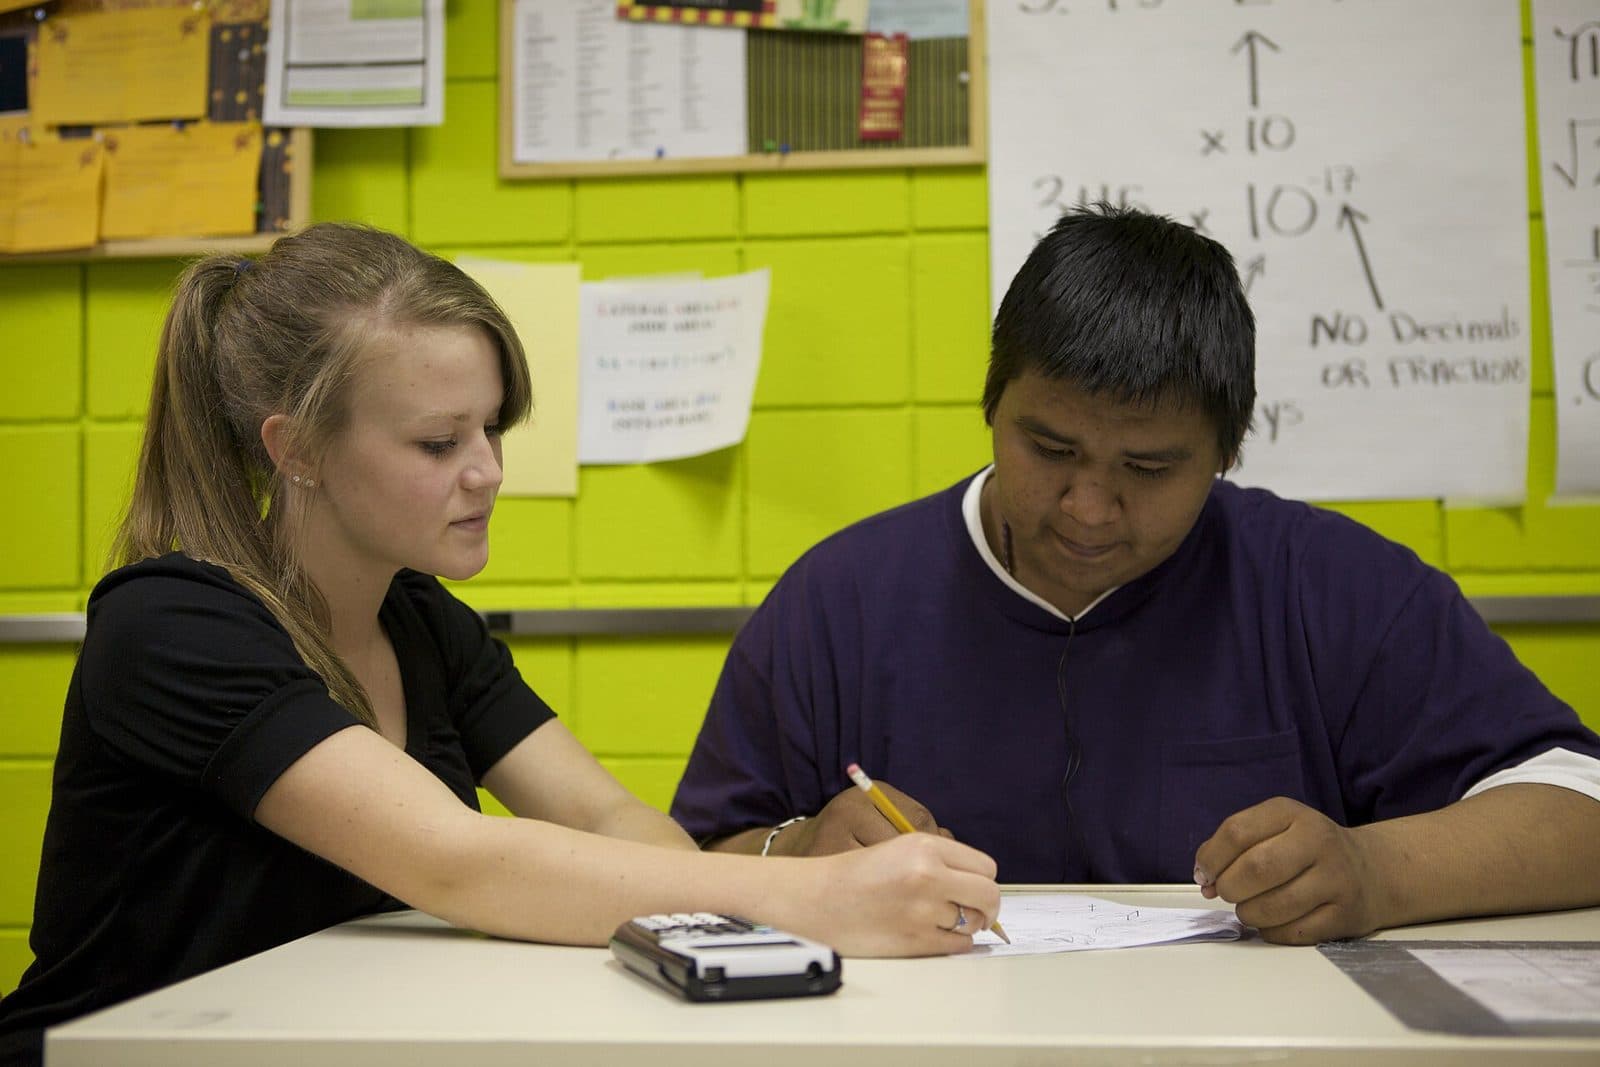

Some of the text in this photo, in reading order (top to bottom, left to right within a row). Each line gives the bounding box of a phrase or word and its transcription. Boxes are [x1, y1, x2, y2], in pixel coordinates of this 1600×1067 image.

[1246, 116, 1296, 154] 10
[1247, 183, 1318, 239] 10
[1310, 305, 1520, 347] NO Decimals
[1321, 357, 1370, 388] OR
